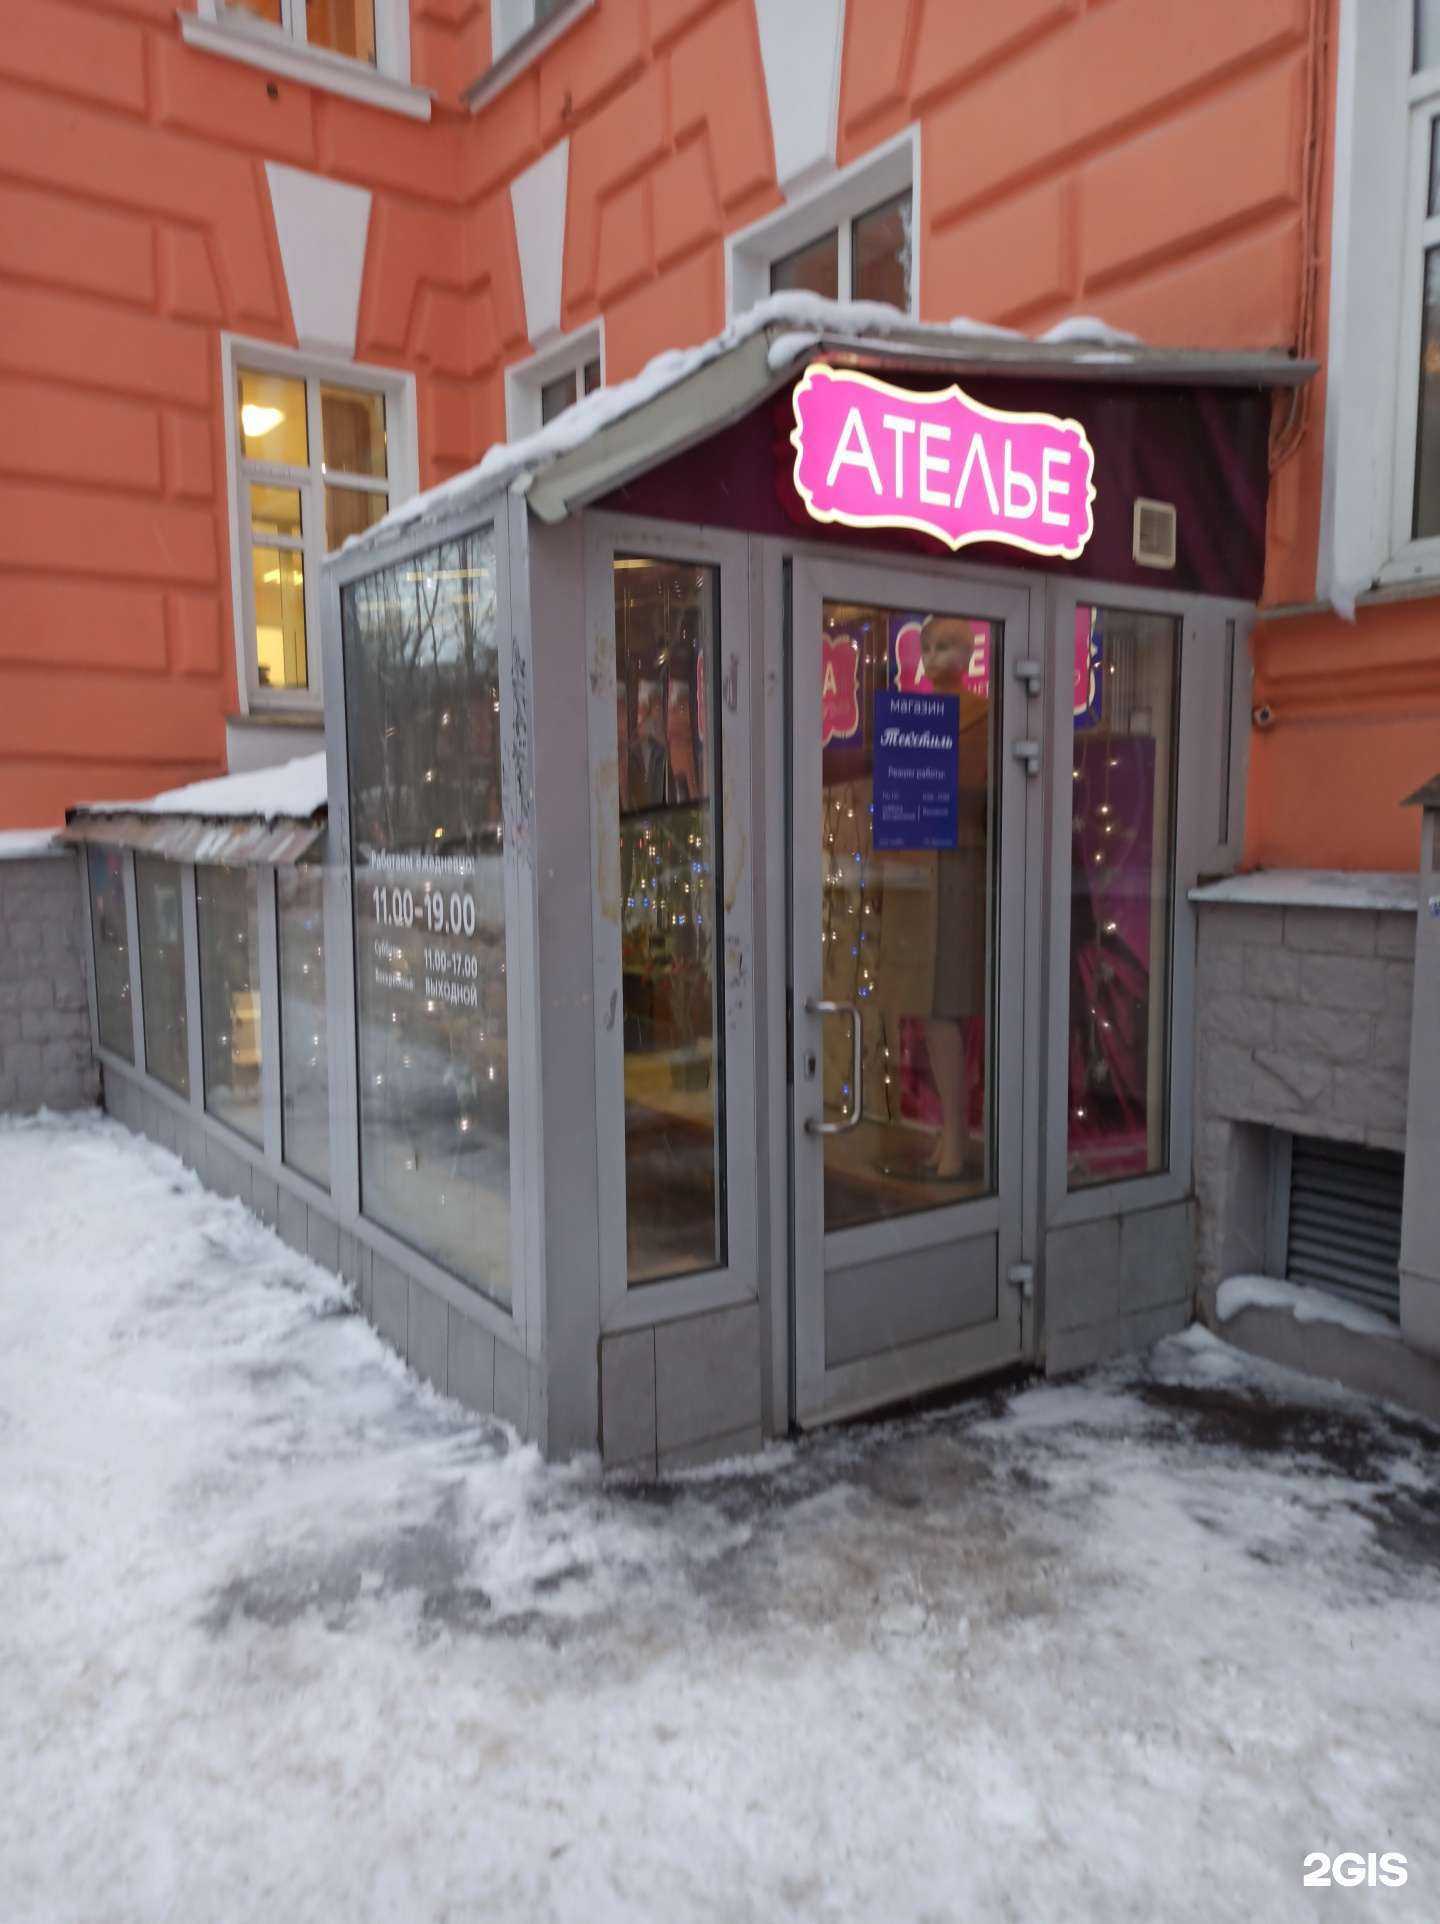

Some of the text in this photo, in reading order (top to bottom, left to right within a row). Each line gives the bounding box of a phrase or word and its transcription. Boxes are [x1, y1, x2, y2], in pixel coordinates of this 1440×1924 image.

[826, 406, 1071, 527] АТЕЛЬЕ
[881, 727, 953, 750] Текстиль
[373, 886, 475, 937] 11.00-19.00
[424, 946, 478, 979] 11.00-17.00
